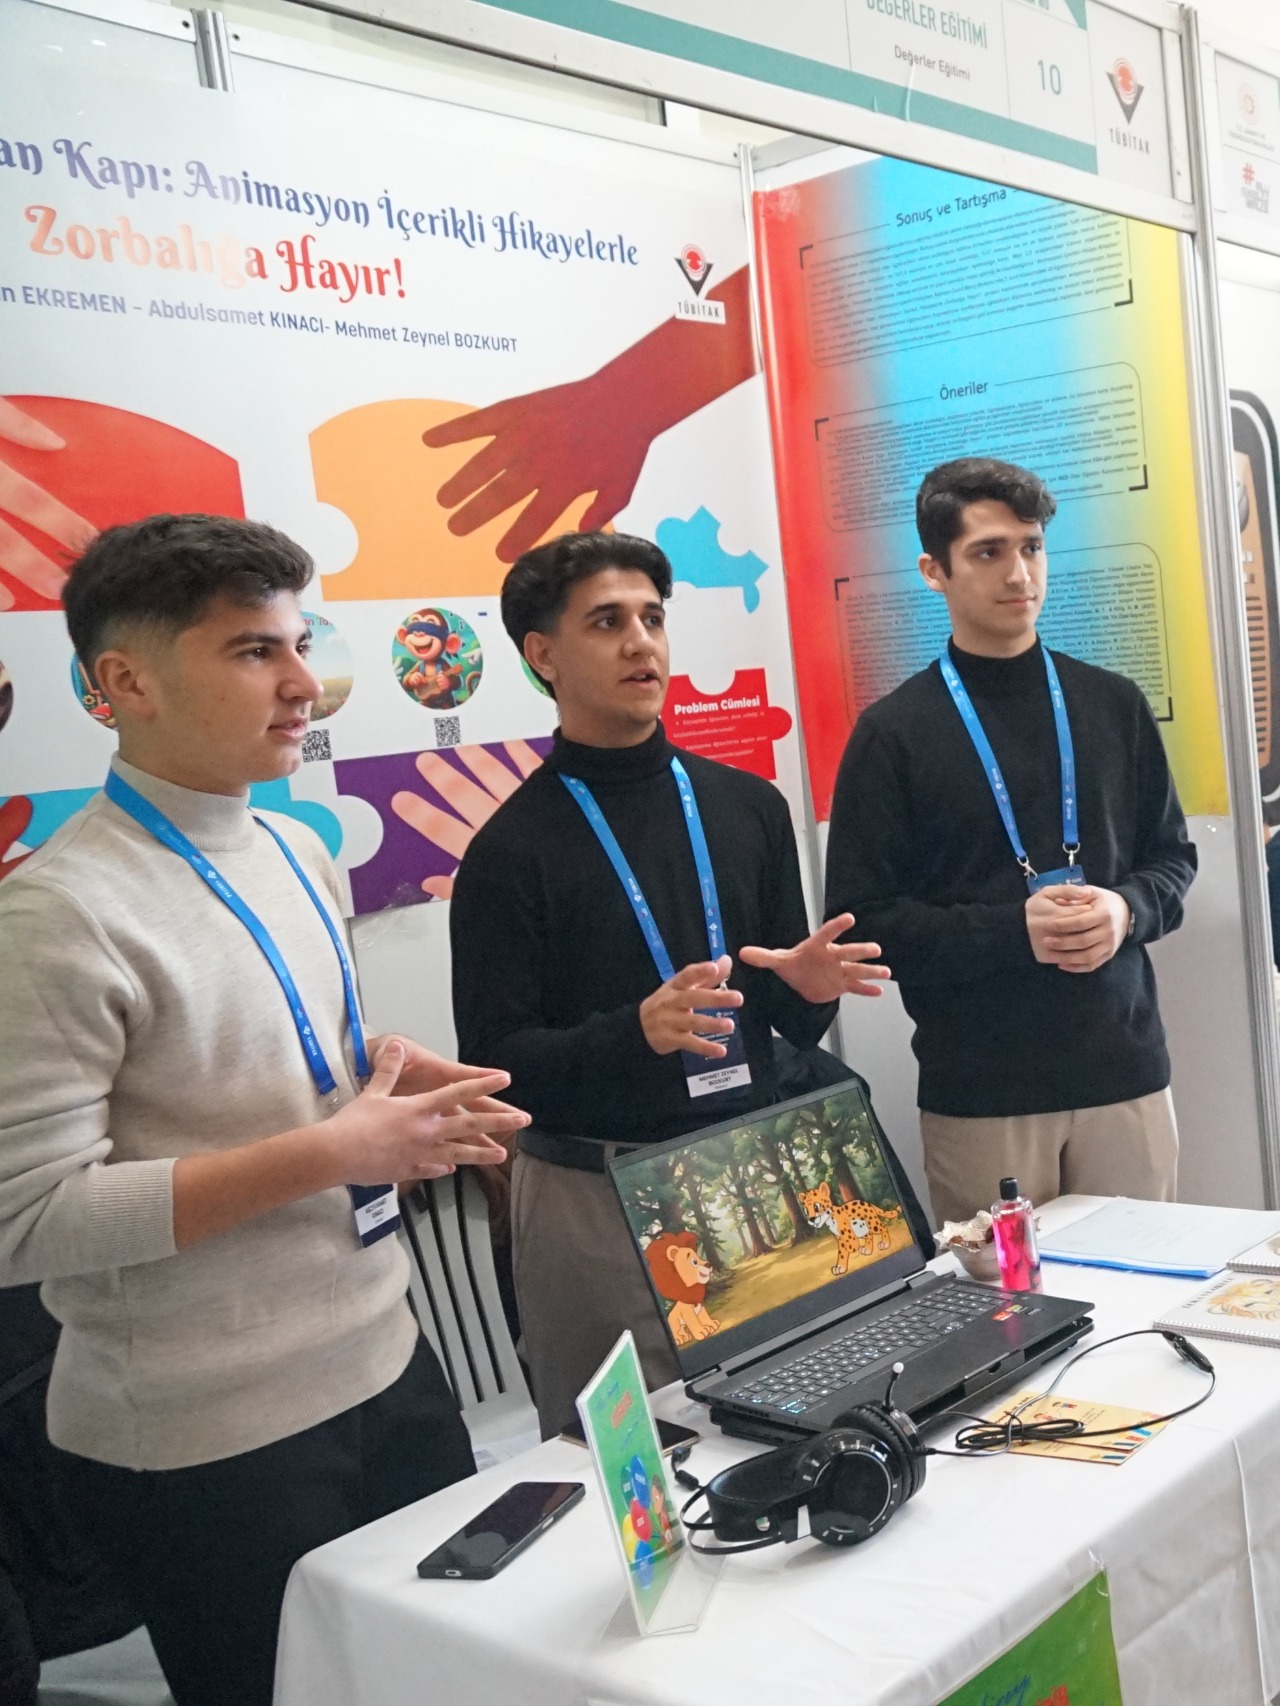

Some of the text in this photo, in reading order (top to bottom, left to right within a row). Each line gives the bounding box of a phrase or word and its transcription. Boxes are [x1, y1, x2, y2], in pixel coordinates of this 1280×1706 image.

[940, 11, 988, 49] EĞİTİMİ
[894, 45, 971, 80] Değerler Eğitimi
[1037, 59, 1062, 95] 10
[1109, 127, 1150, 155] TÜBİTAK
[53, 138, 174, 199] Kapı:
[183, 160, 370, 228] Animasyon
[377, 189, 486, 250] İçerikli
[491, 211, 639, 266] Hikayelerle
[896, 188, 1007, 227] Sonuç ve Tartışma
[24, 204, 405, 303] Zorbalığa Hayır!
[21, 285, 127, 315] EKREMEN
[149, 299, 265, 327] Abdulsamet
[335, 320, 398, 342] Mehmet
[402, 327, 450, 348] Zeynel
[455, 332, 517, 352] BOZKURT
[678, 300, 720, 318] TÜBİTAK
[939, 381, 990, 400] Öneriler
[674, 695, 760, 715] Problem Cümlesi
